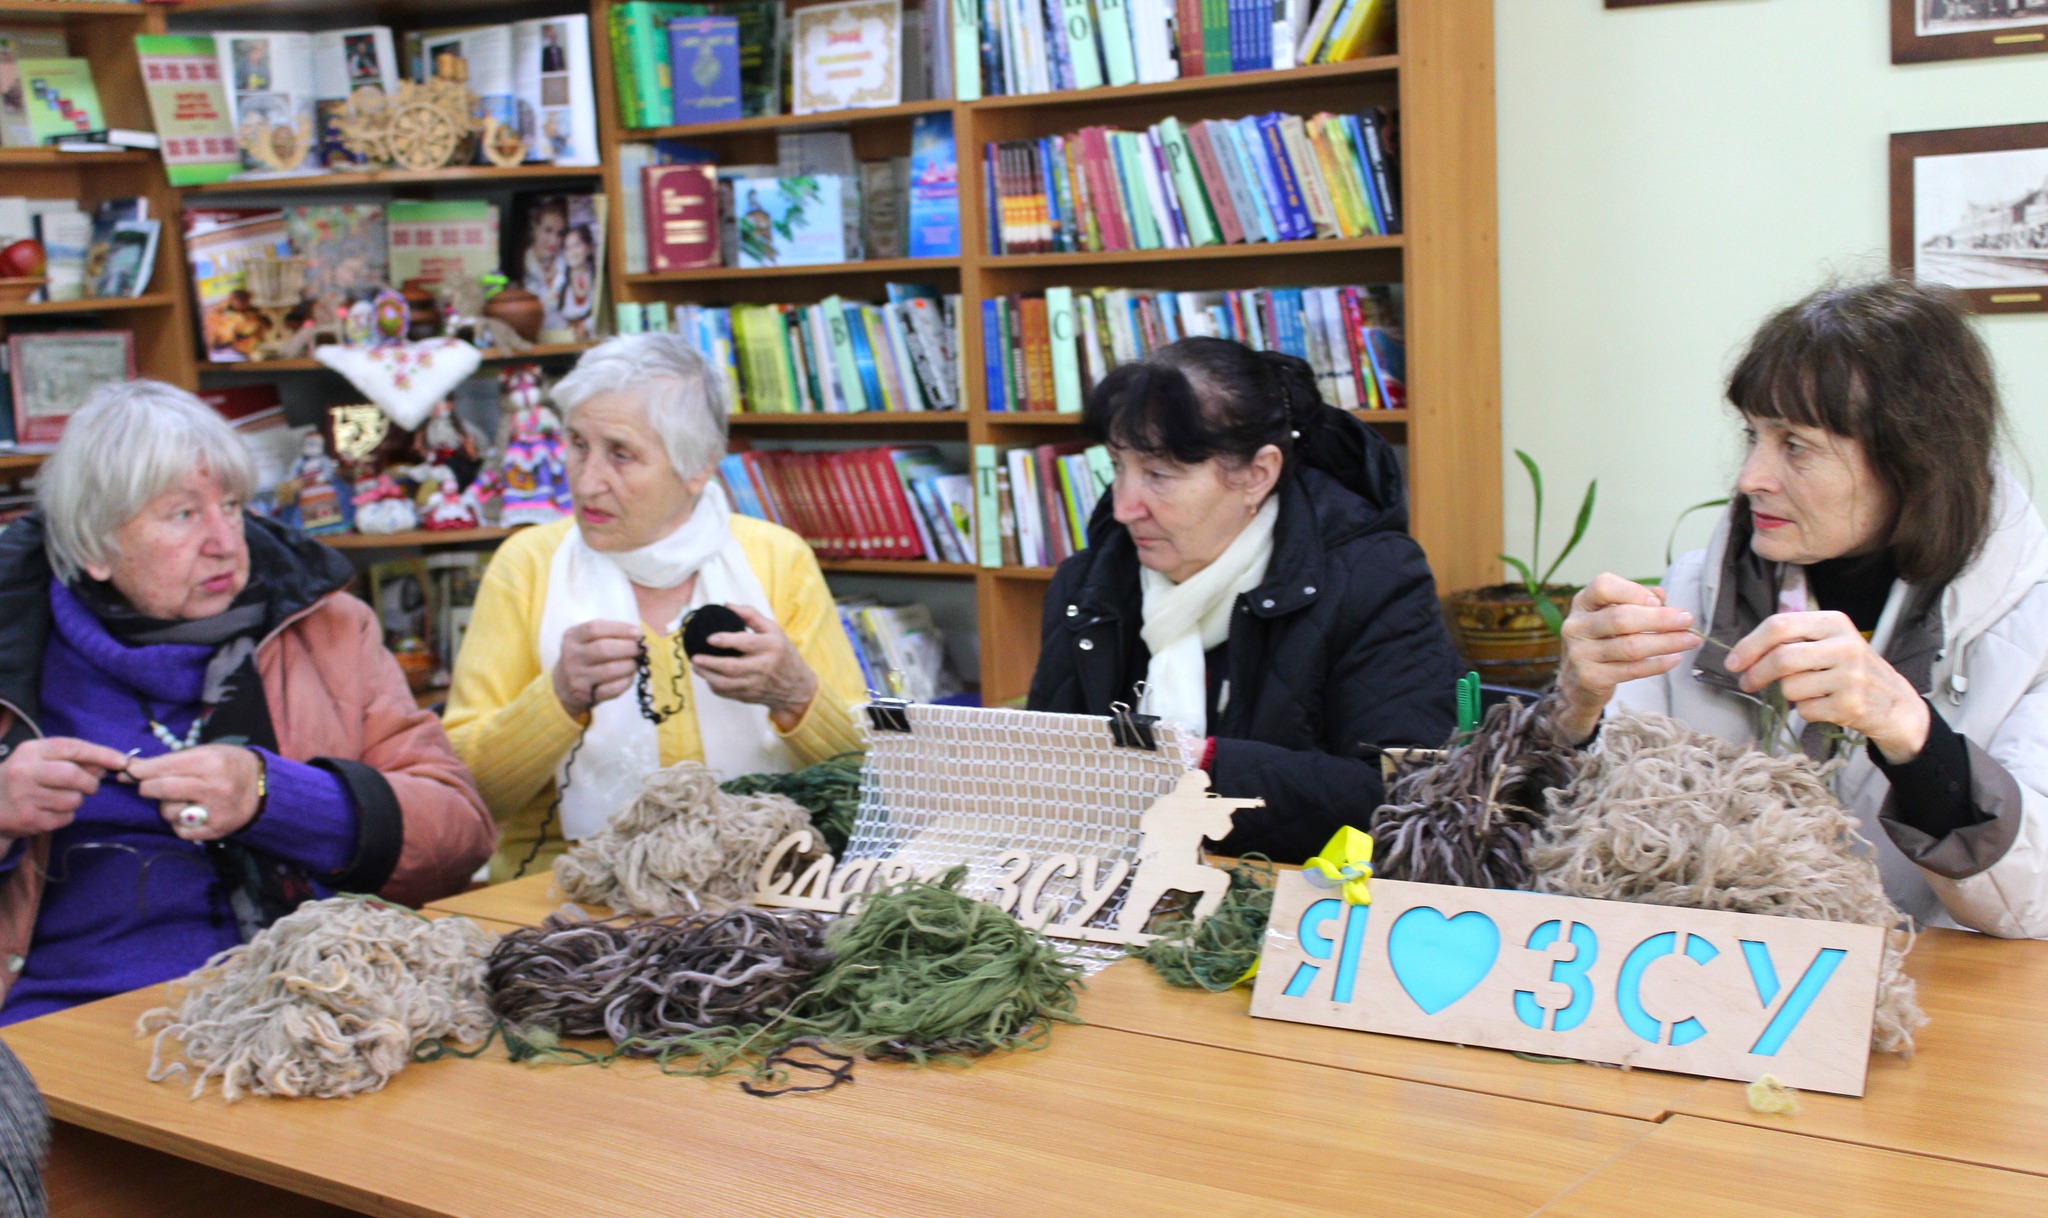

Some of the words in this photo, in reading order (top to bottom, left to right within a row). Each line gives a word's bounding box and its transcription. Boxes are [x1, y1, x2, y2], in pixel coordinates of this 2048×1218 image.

[977, 466, 996, 496] Т
[1281, 897, 1371, 1004] Я
[1513, 918, 1848, 1057] ЗСУ
